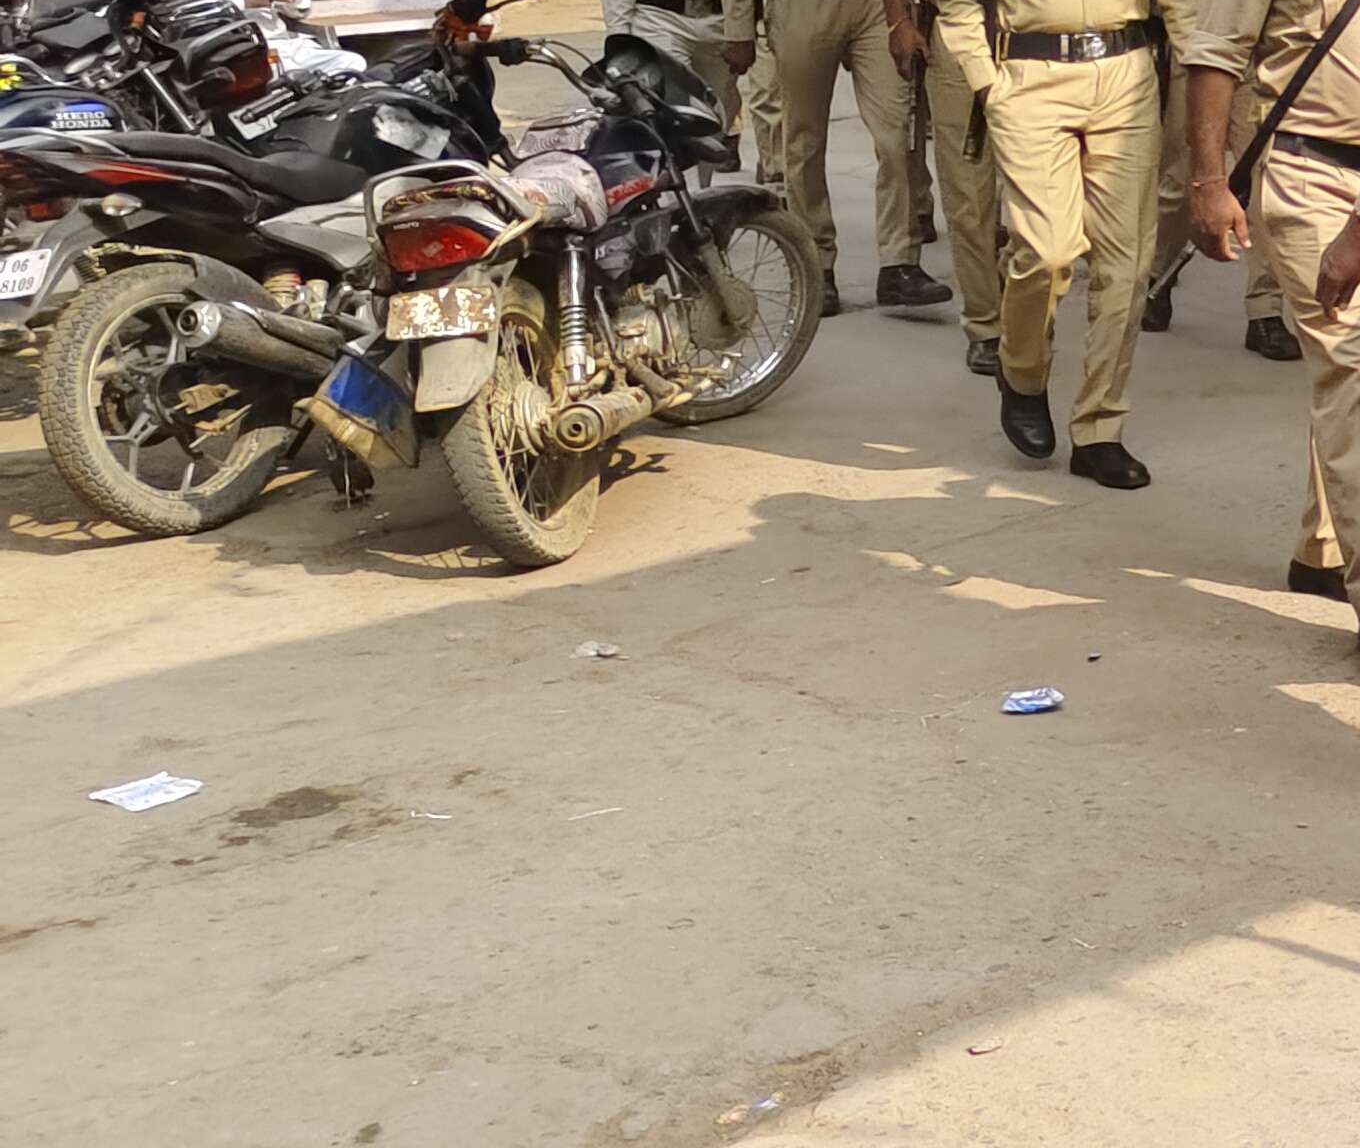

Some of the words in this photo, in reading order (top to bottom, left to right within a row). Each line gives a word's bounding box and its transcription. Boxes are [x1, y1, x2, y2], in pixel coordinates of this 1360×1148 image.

[55, 111, 106, 121] HERO
[50, 120, 113, 130] HONDA
[11, 258, 30, 274] 06
